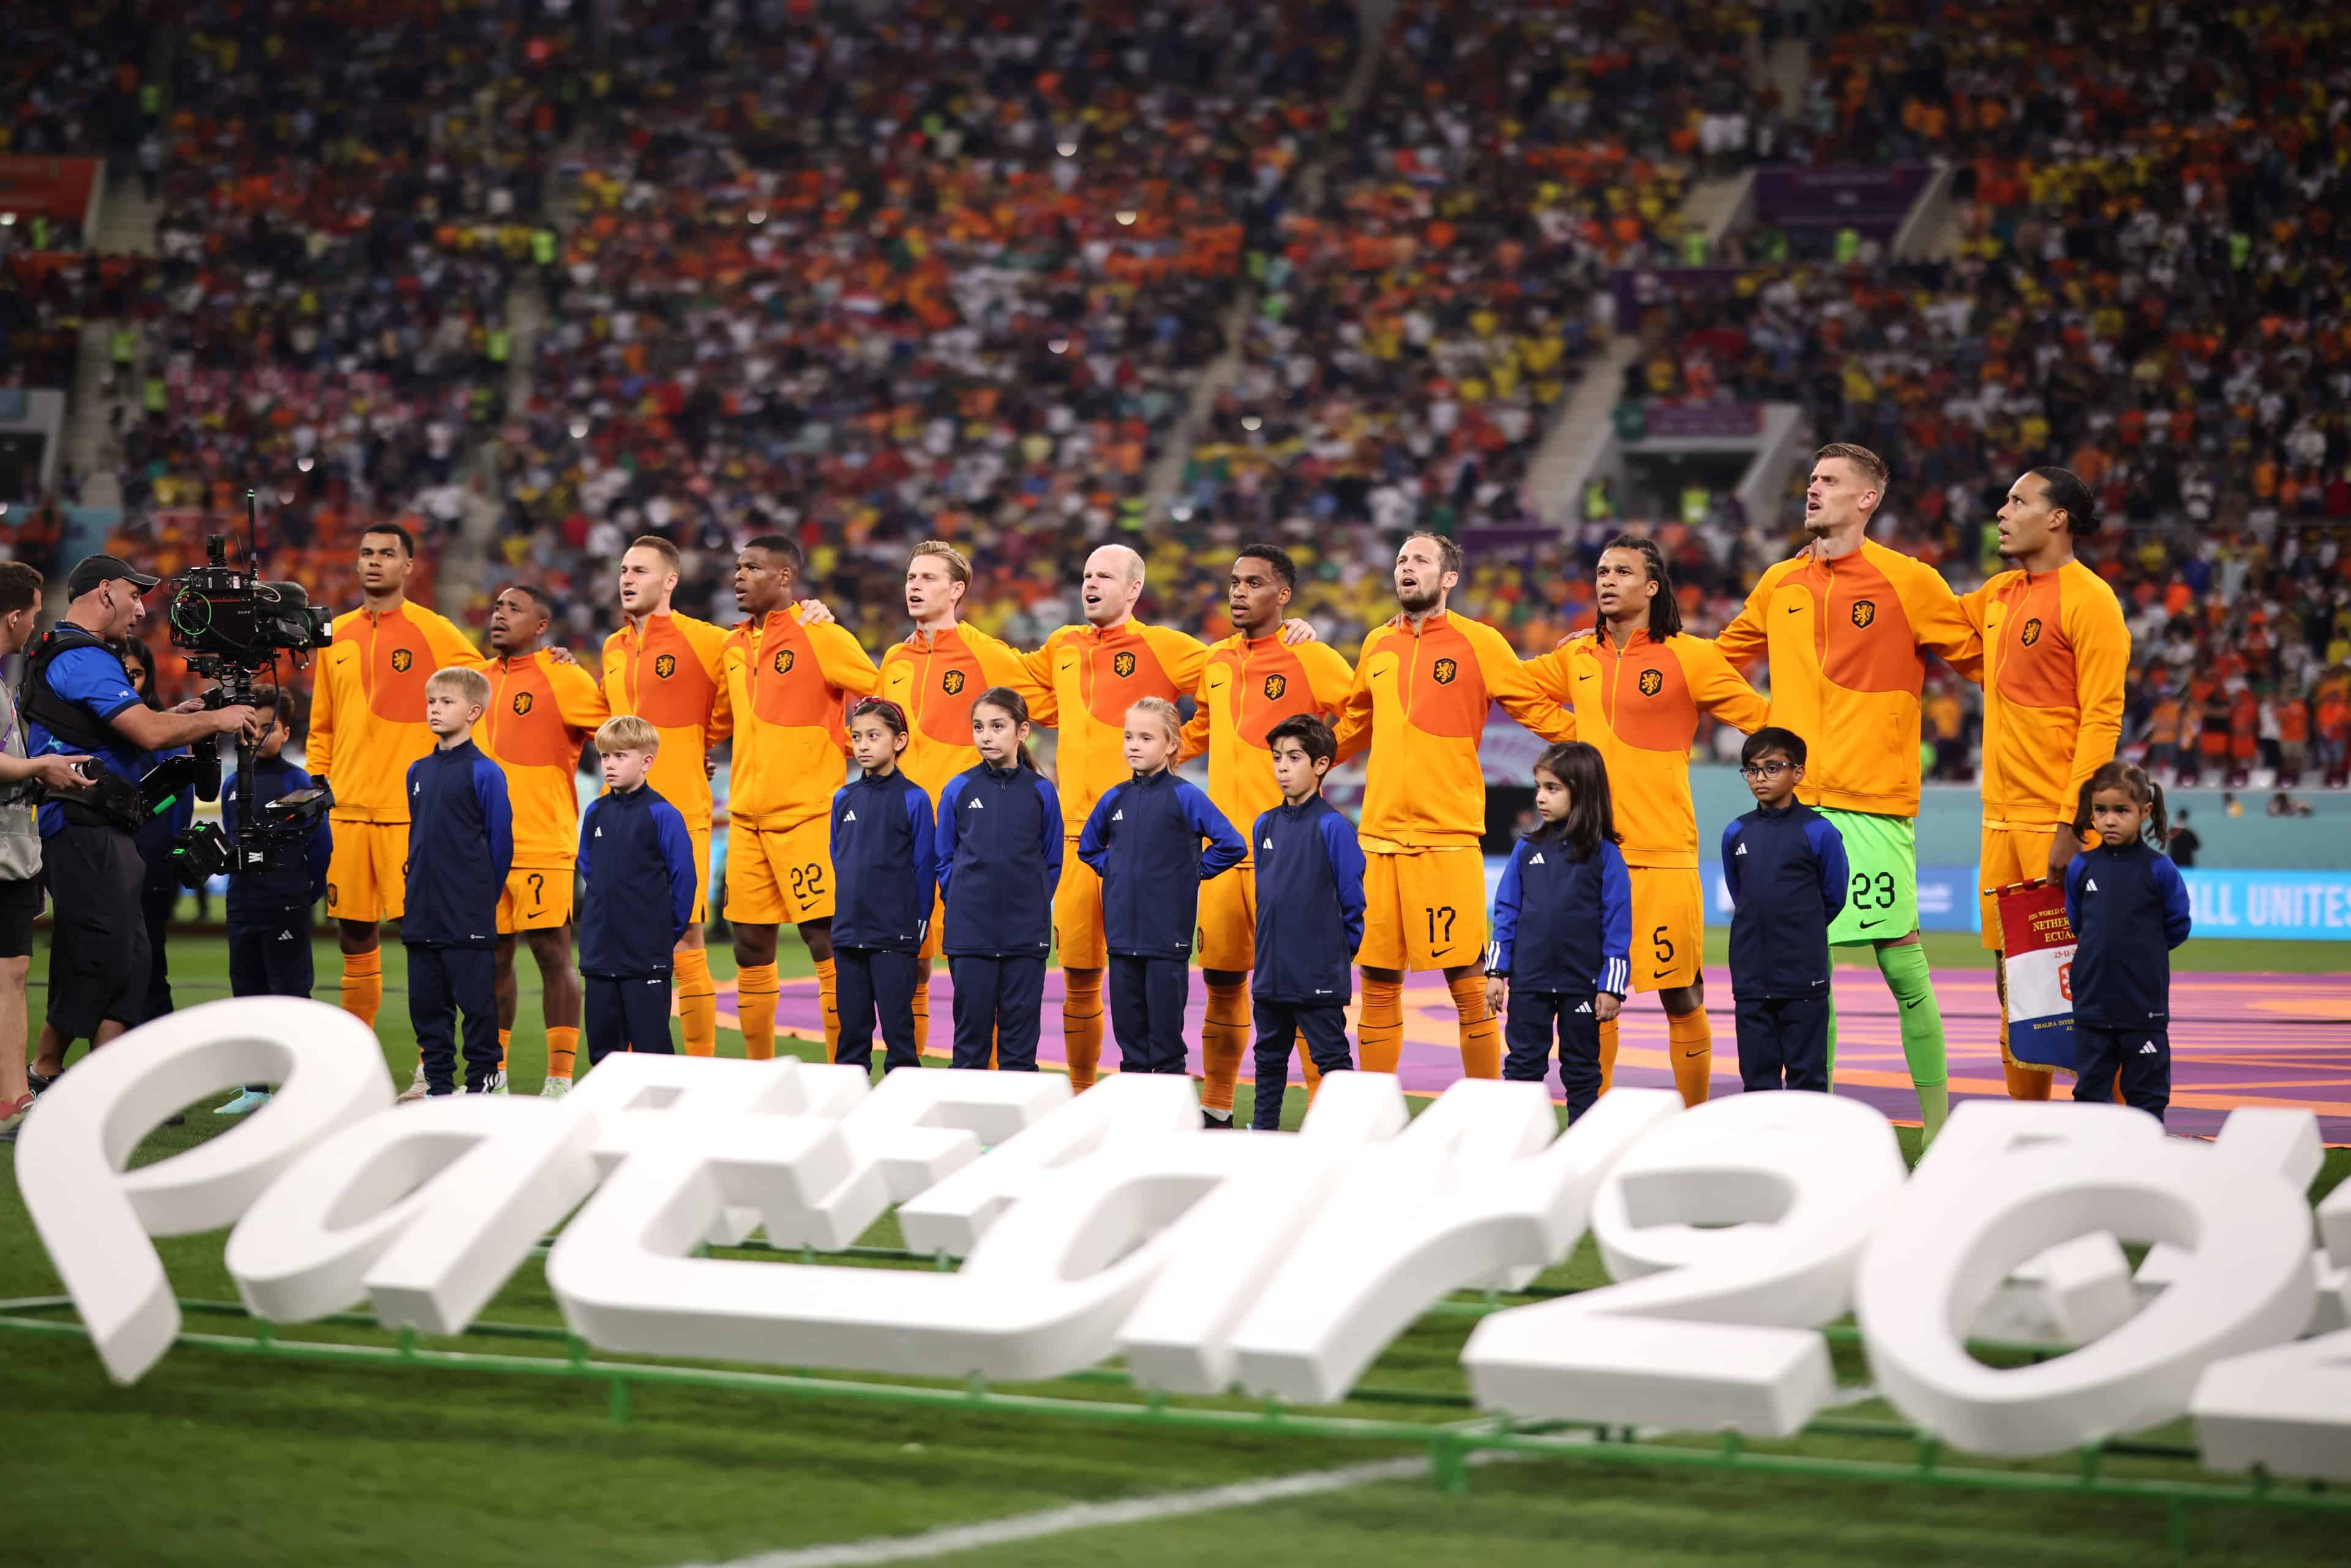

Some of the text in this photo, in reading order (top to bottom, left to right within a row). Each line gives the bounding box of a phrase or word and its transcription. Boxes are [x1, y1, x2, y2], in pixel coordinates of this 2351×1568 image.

[528, 873, 544, 905] 7
[790, 863, 825, 899] 22
[1851, 871, 1895, 909] 23
[2038, 908, 2060, 917] WORLD
[2246, 883, 2351, 928] UNITE
[1425, 906, 1456, 943] 17
[2033, 917, 2070, 931] NETHER
[2044, 930, 2076, 942] ECUA
[1653, 925, 1674, 962] 5
